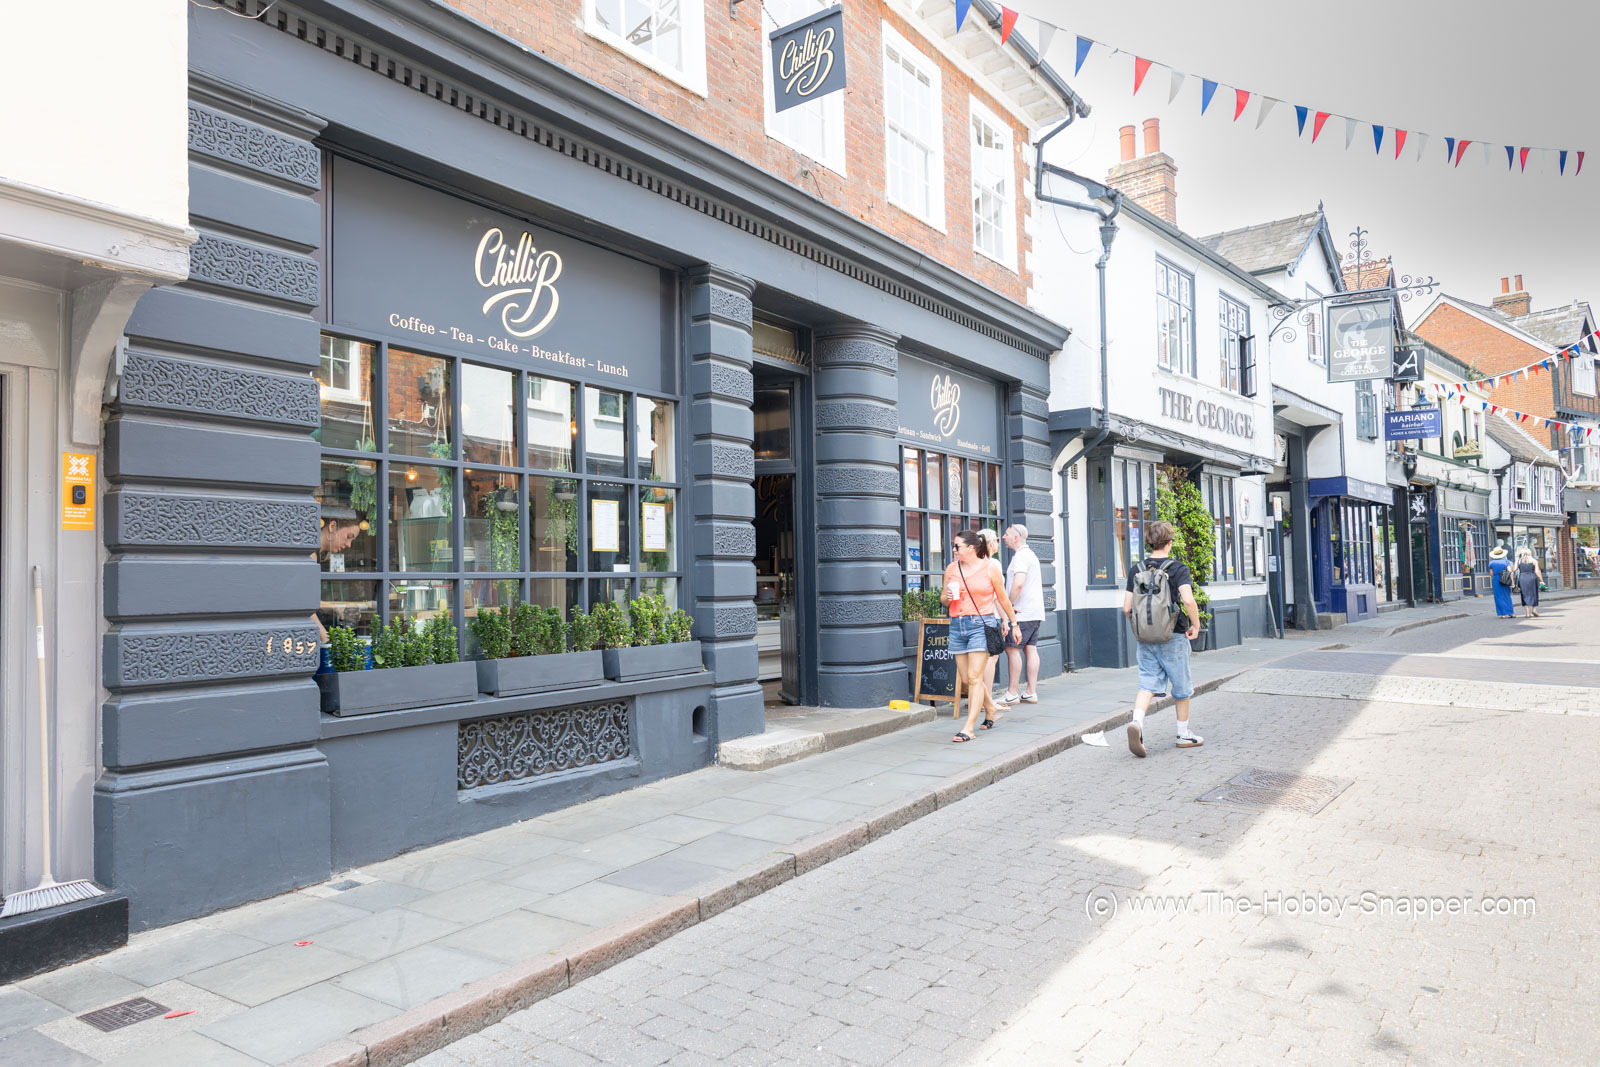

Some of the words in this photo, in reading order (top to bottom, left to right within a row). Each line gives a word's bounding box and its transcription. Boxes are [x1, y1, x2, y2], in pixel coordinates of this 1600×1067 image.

[389, 313, 435, 335] Coffee
[450, 326, 474, 344] Tea
[487, 336, 519, 354] Cake
[531, 345, 587, 368] Breakfast
[596, 360, 629, 378] Lunch
[1350, 338, 1369, 347] THE
[1333, 345, 1386, 359] GEORGE
[1158, 386, 1193, 423] THE
[1196, 399, 1254, 439] GEORGE
[1390, 413, 1435, 423] MARIANO
[919, 430, 942, 442] Sandwich
[957, 438, 978, 451] Handmade
[981, 444, 991, 453] Grill
[266, 636, 317, 655] 1857
